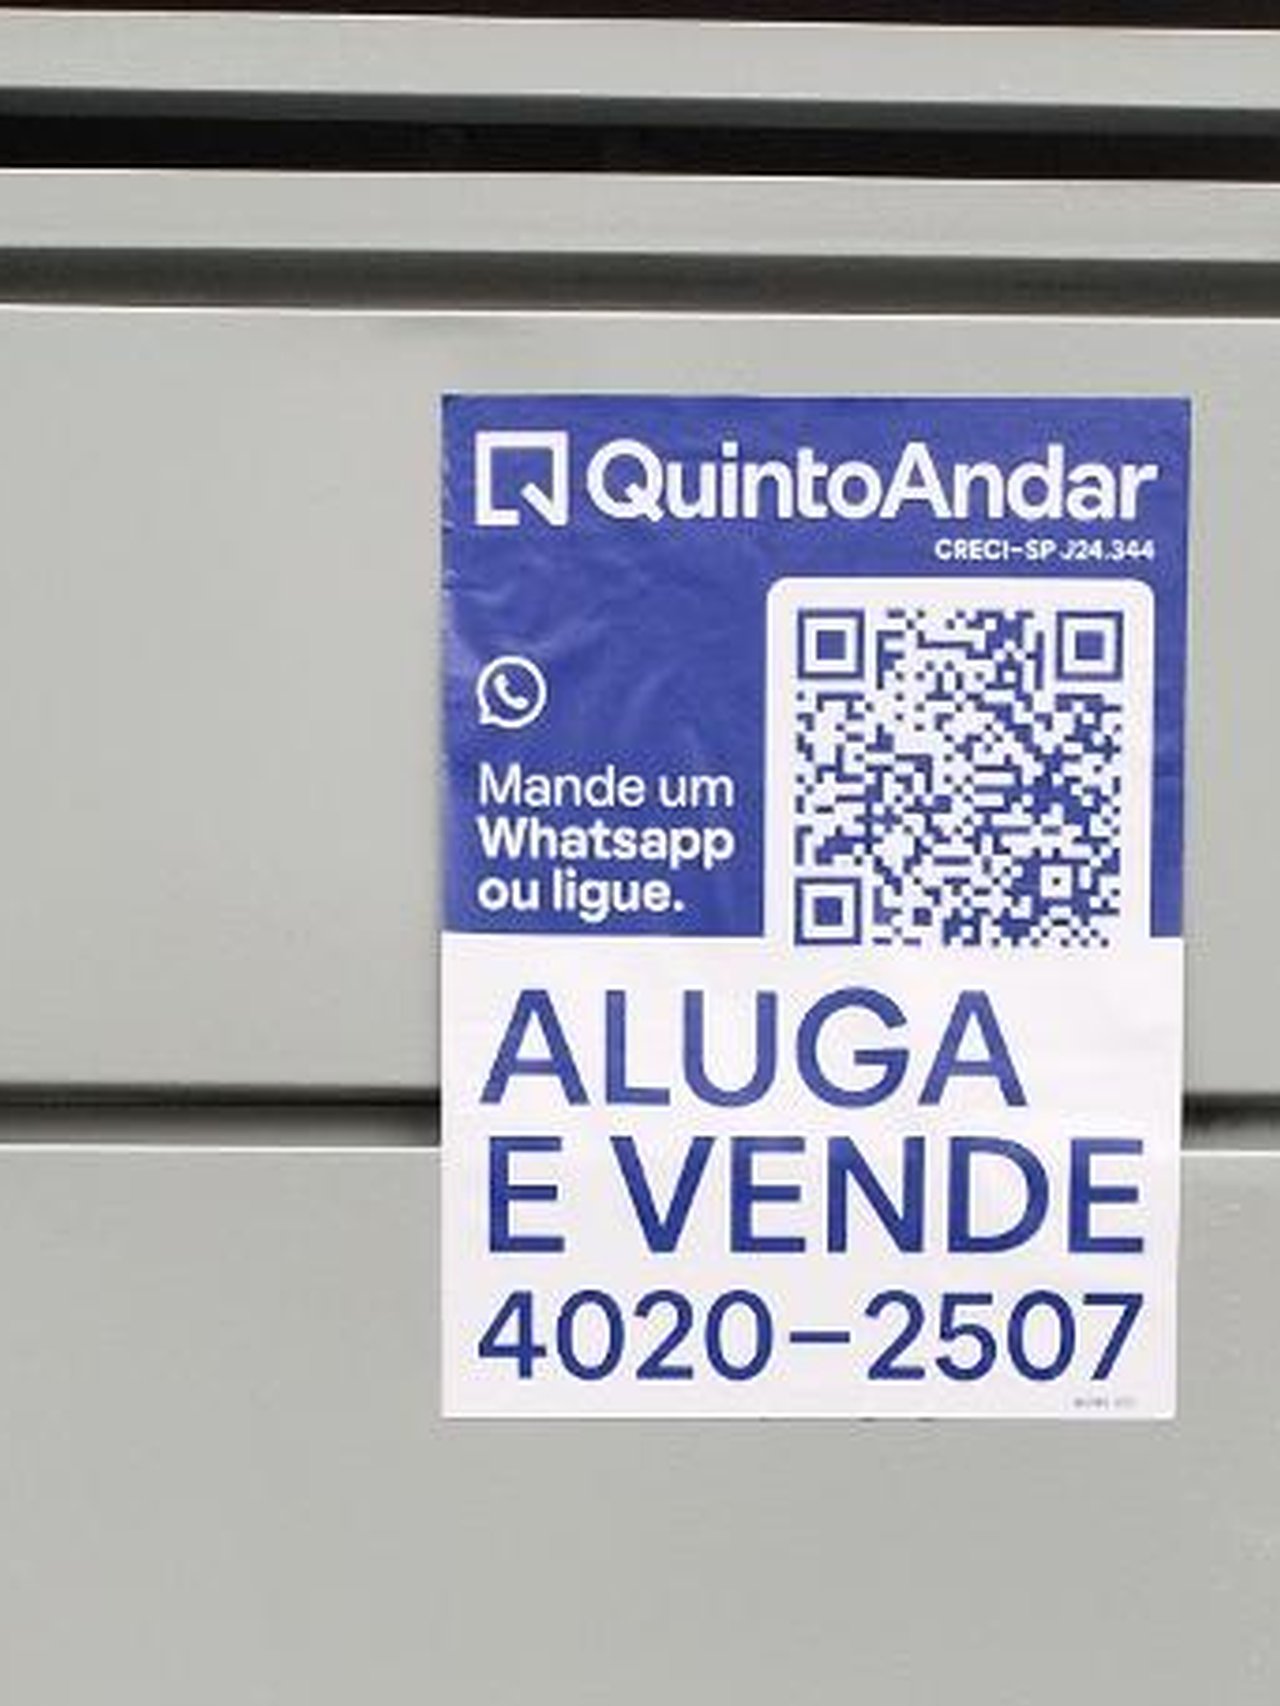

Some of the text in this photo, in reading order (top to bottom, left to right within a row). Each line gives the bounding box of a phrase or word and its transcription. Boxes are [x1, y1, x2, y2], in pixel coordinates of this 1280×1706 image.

[586, 439, 1159, 523] QuintoAndar
[933, 538, 1057, 560] CRECI-SP
[479, 762, 735, 807] Mande um
[477, 815, 736, 870] Whatsapp
[478, 867, 685, 922] ou ligue.
[479, 986, 1028, 1109] ALUGA
[488, 1135, 1145, 1255] E VENDE
[477, 1289, 1144, 1382] 4020-2507
